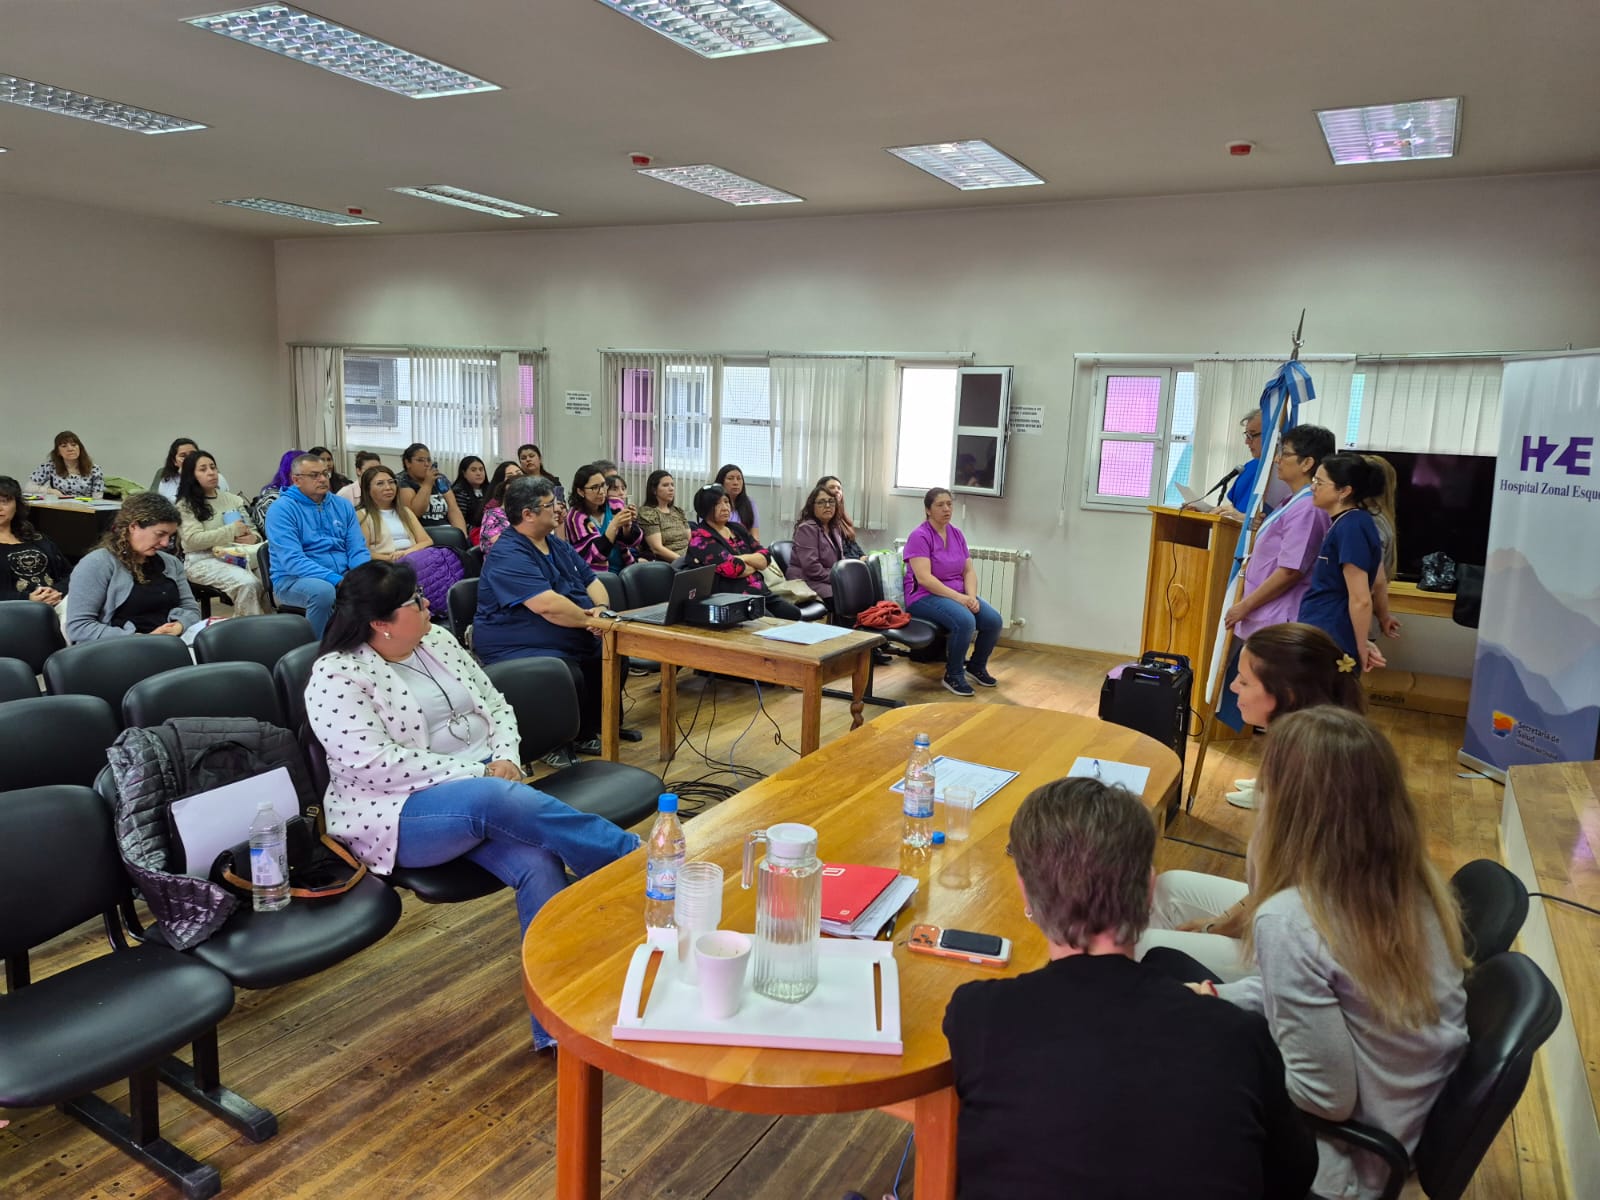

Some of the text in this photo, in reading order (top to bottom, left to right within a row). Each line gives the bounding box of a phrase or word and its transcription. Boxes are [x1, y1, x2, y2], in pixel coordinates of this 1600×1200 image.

[1520, 435, 1594, 476] HZE
[1500, 479, 1539, 495] Hospital
[1541, 482, 1570, 497] Zonal
[1518, 729, 1535, 743] Salud
[1551, 735, 1560, 744] de
